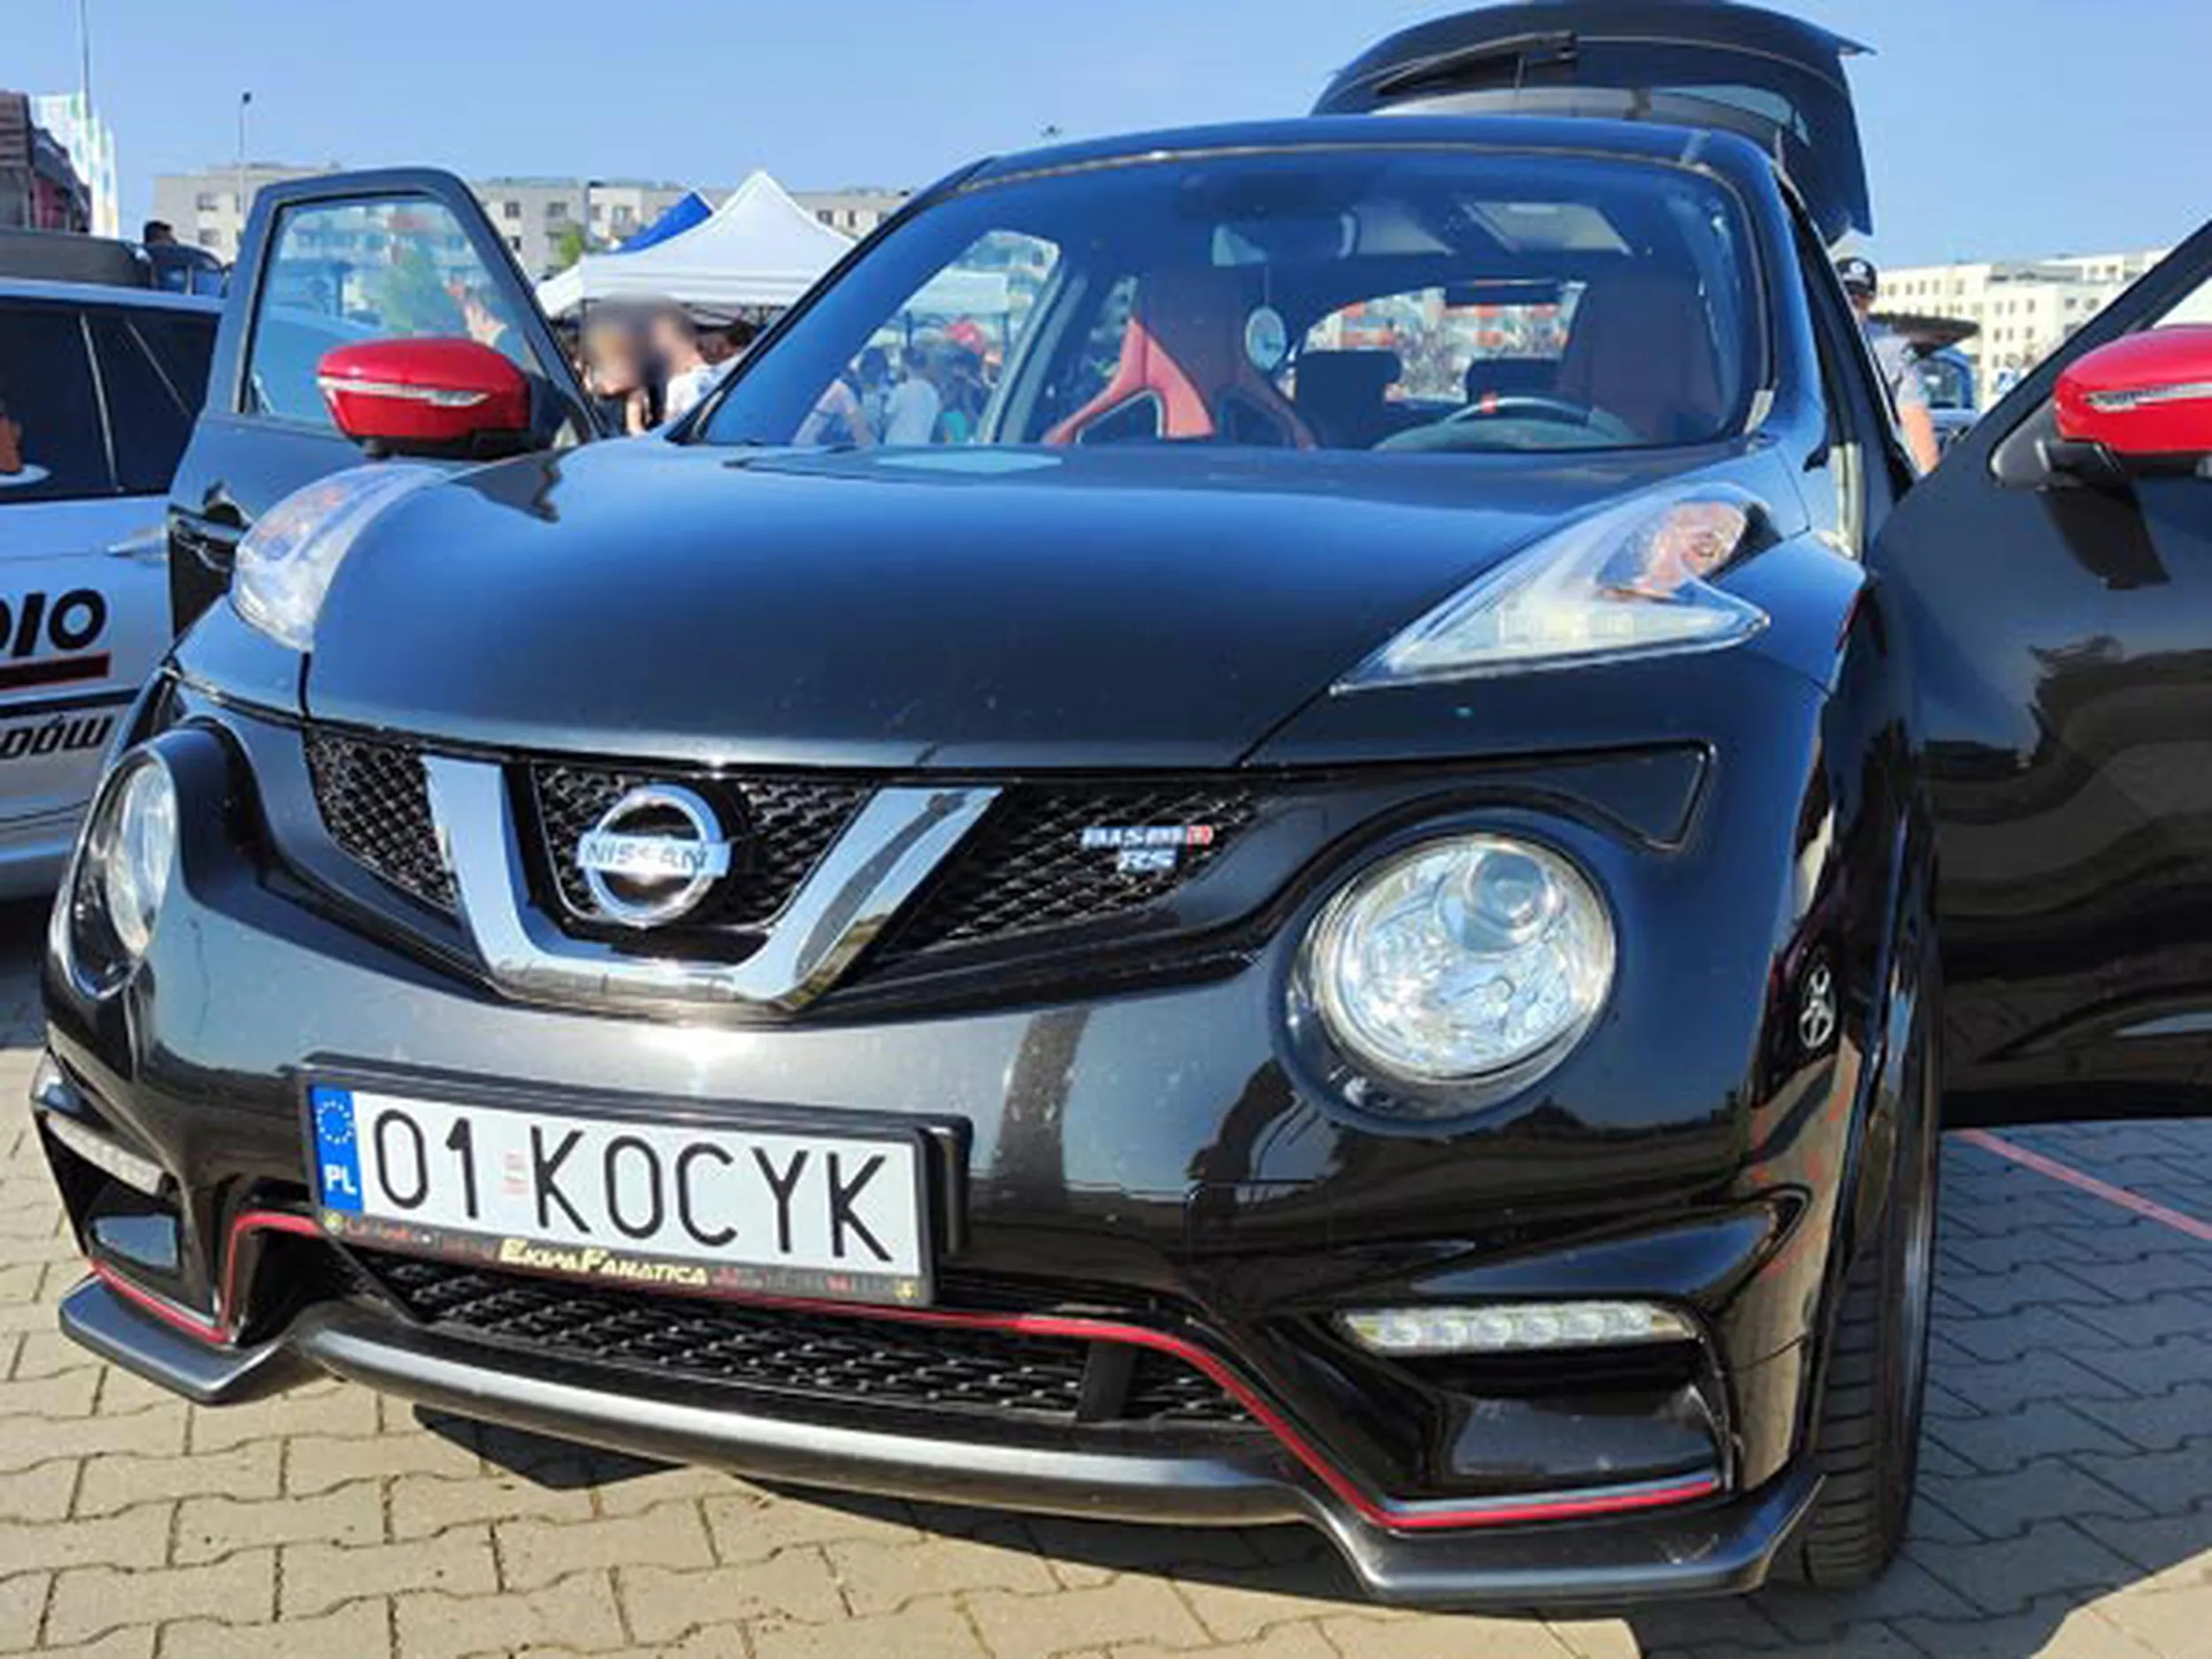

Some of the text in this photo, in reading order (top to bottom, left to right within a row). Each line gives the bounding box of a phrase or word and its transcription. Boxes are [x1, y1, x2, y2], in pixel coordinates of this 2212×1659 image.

[583, 837, 710, 874] NISSAN
[324, 1164, 357, 1194] PL
[530, 1125, 894, 1262] KOCYK
